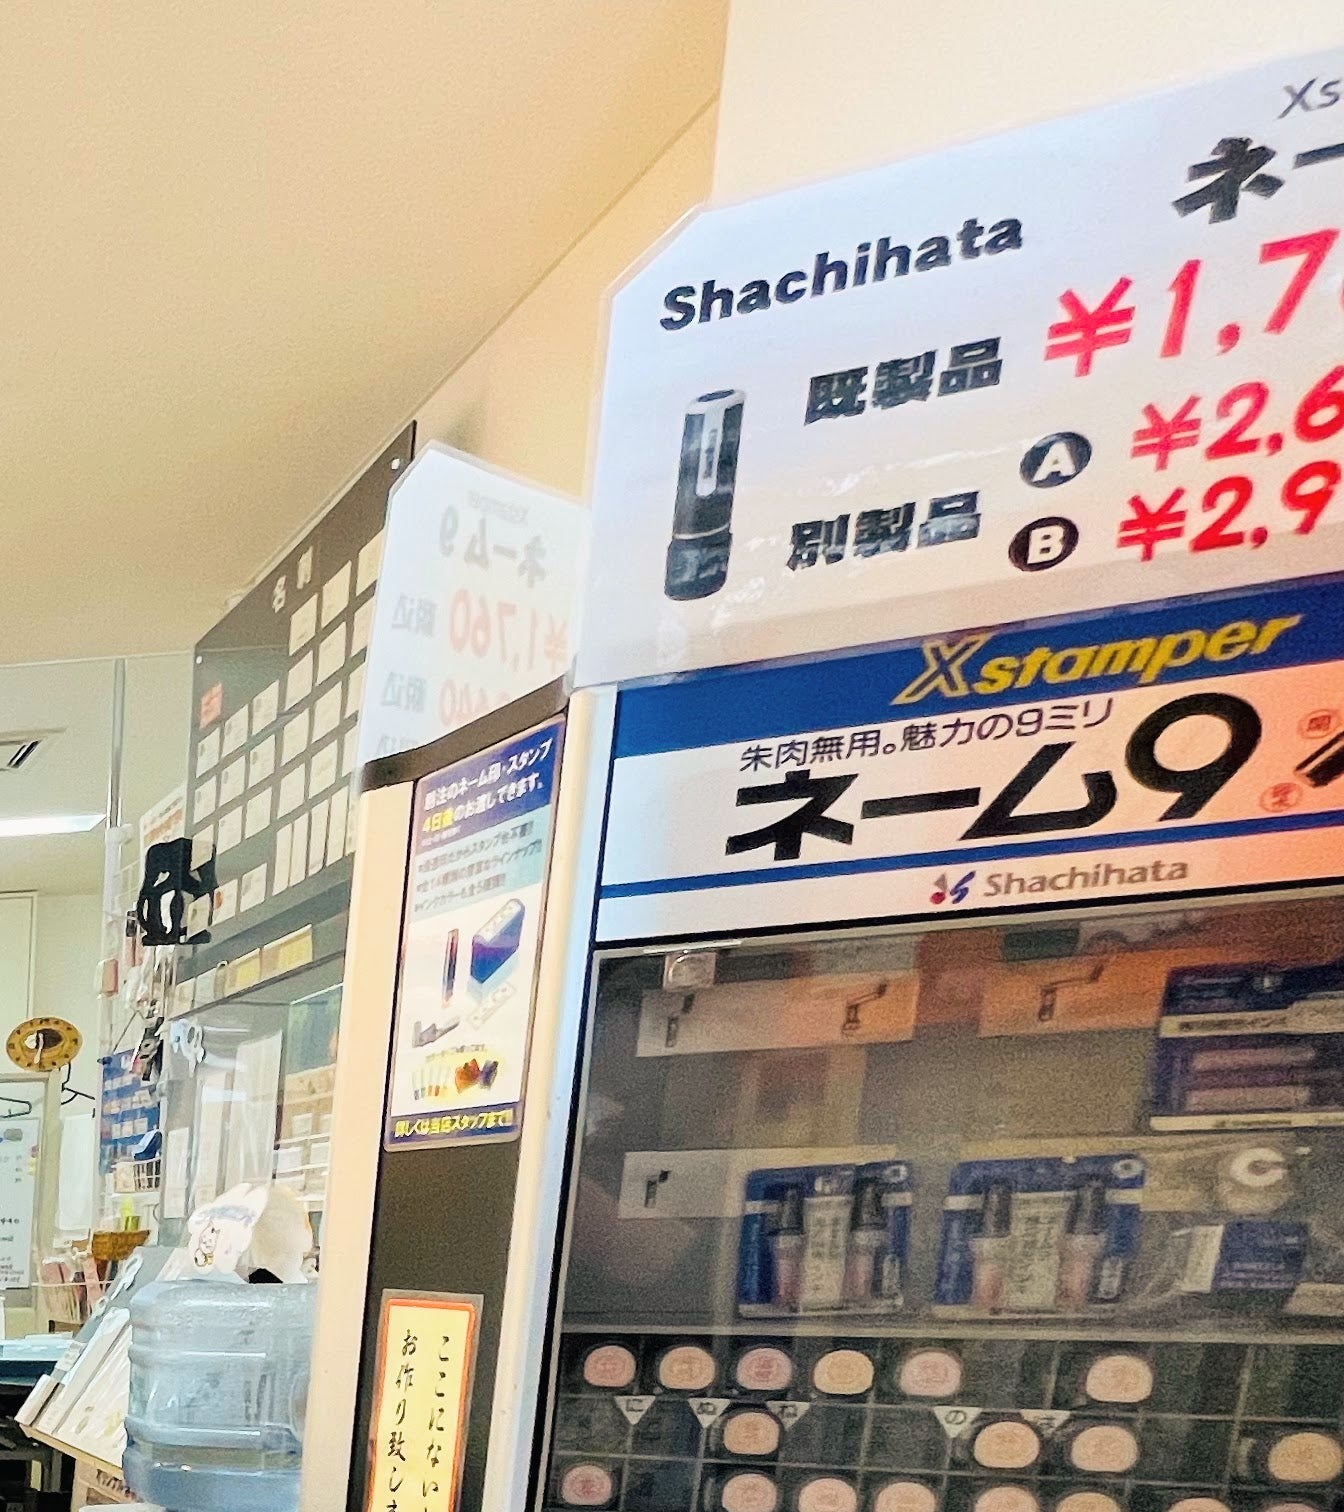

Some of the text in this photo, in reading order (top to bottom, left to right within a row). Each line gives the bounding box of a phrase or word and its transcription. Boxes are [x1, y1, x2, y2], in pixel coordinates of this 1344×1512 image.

[660, 216, 1024, 333] Shachihata
[1044, 227, 1344, 378] ¥1,7
[804, 337, 1003, 426] 既製品
[786, 491, 981, 572] 別製品
[891, 614, 1305, 706] Xstamper
[725, 692, 1263, 862] ネーム9
[738, 697, 1113, 774] 朱肉無用。魅力の9ミリ
[983, 857, 1189, 897] Shachihata
